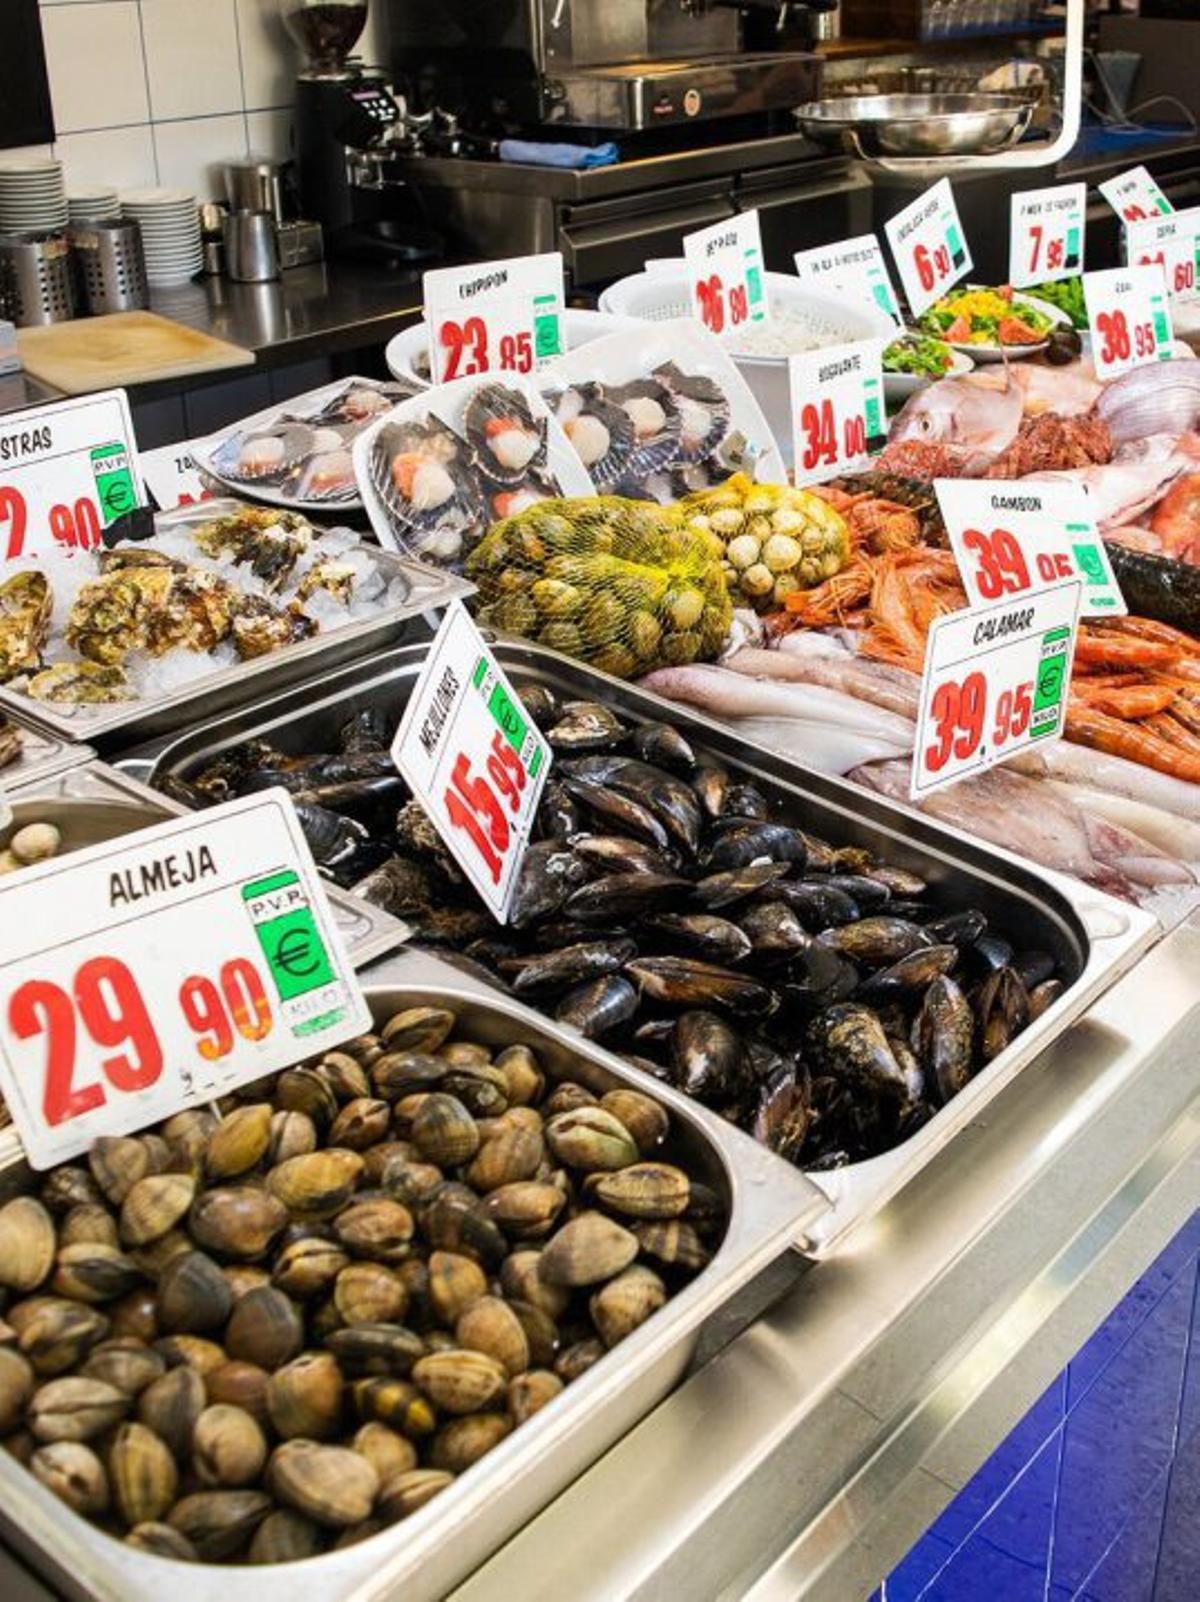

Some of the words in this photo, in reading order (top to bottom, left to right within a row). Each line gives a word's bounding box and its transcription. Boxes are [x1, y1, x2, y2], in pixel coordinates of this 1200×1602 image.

[914, 244, 935, 292] 6
[1029, 225, 1043, 272] 7
[440, 316, 489, 384] 23
[1096, 309, 1131, 364] 38
[0, 426, 52, 460] STRAS
[801, 398, 838, 470] 34
[48, 497, 102, 550] 90
[962, 528, 1033, 600] 39
[973, 607, 1035, 646] CALAMAR
[109, 845, 217, 907] ALMEJA
[7, 955, 164, 1128] 29
[178, 957, 274, 1062] 90
